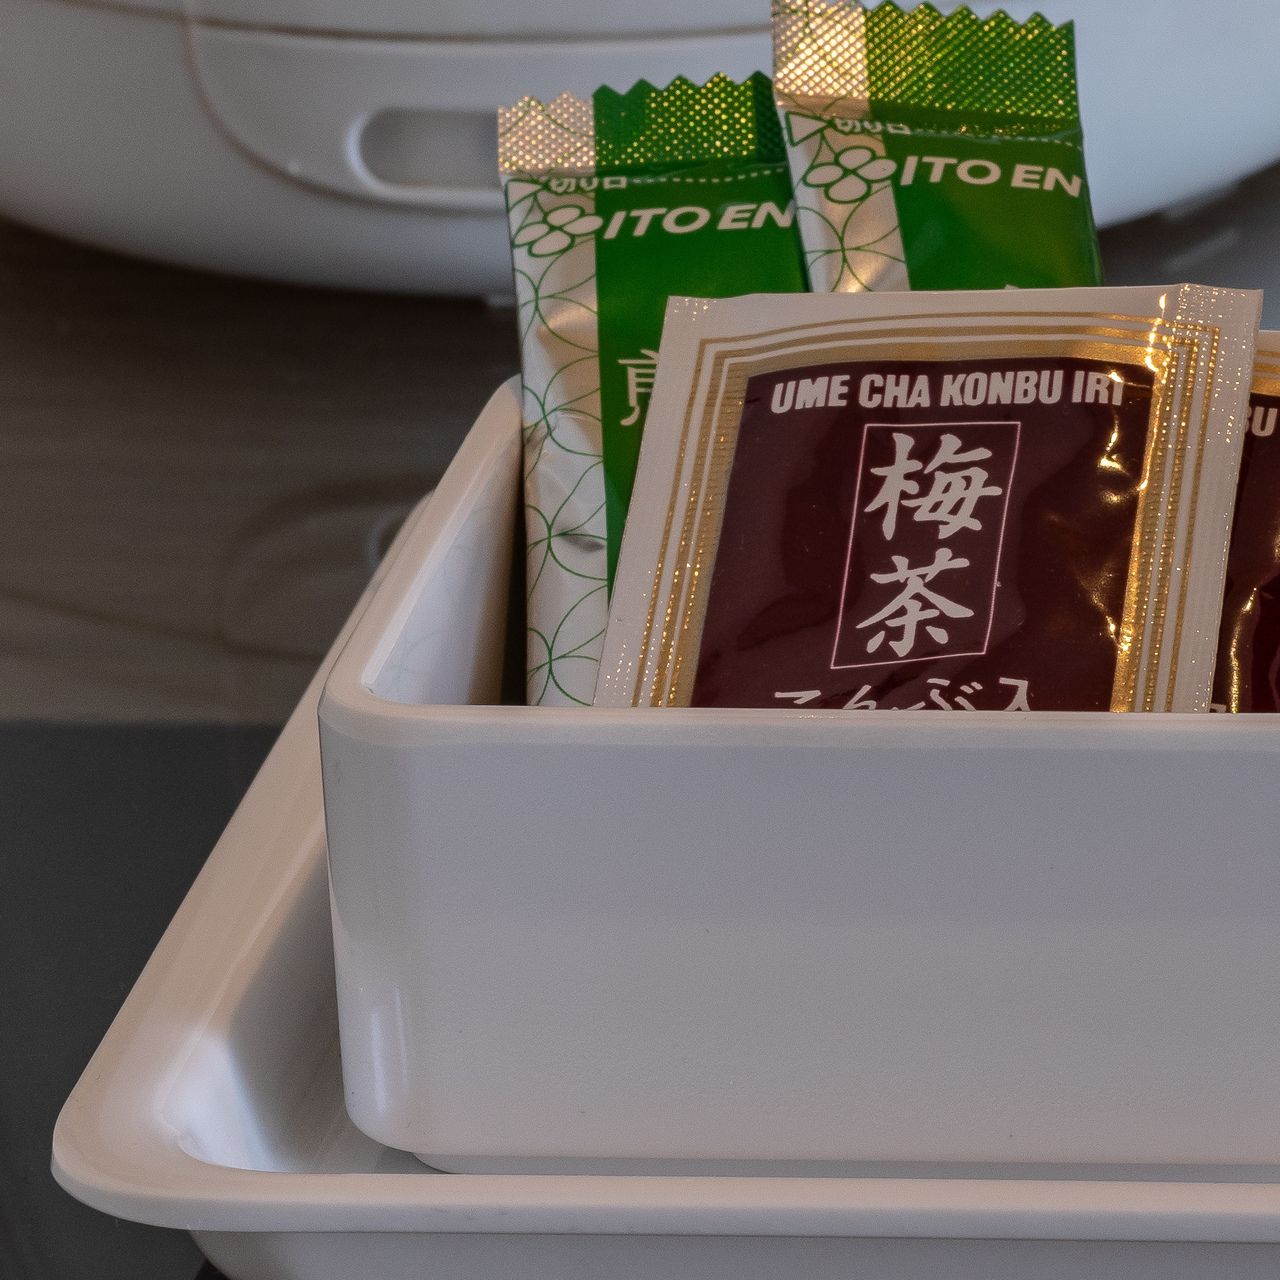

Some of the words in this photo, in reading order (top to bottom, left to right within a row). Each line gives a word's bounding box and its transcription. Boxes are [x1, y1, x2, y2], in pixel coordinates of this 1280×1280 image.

[900, 155, 1001, 187] ITO
[1010, 163, 1082, 198] EN
[603, 206, 710, 239] ITO
[716, 201, 797, 231] EN
[770, 375, 849, 414] UME
[858, 373, 931, 408] CHA
[940, 370, 1064, 407] KONBU
[1072, 371, 1125, 407] IRI
[855, 432, 1004, 658] 梅茶
